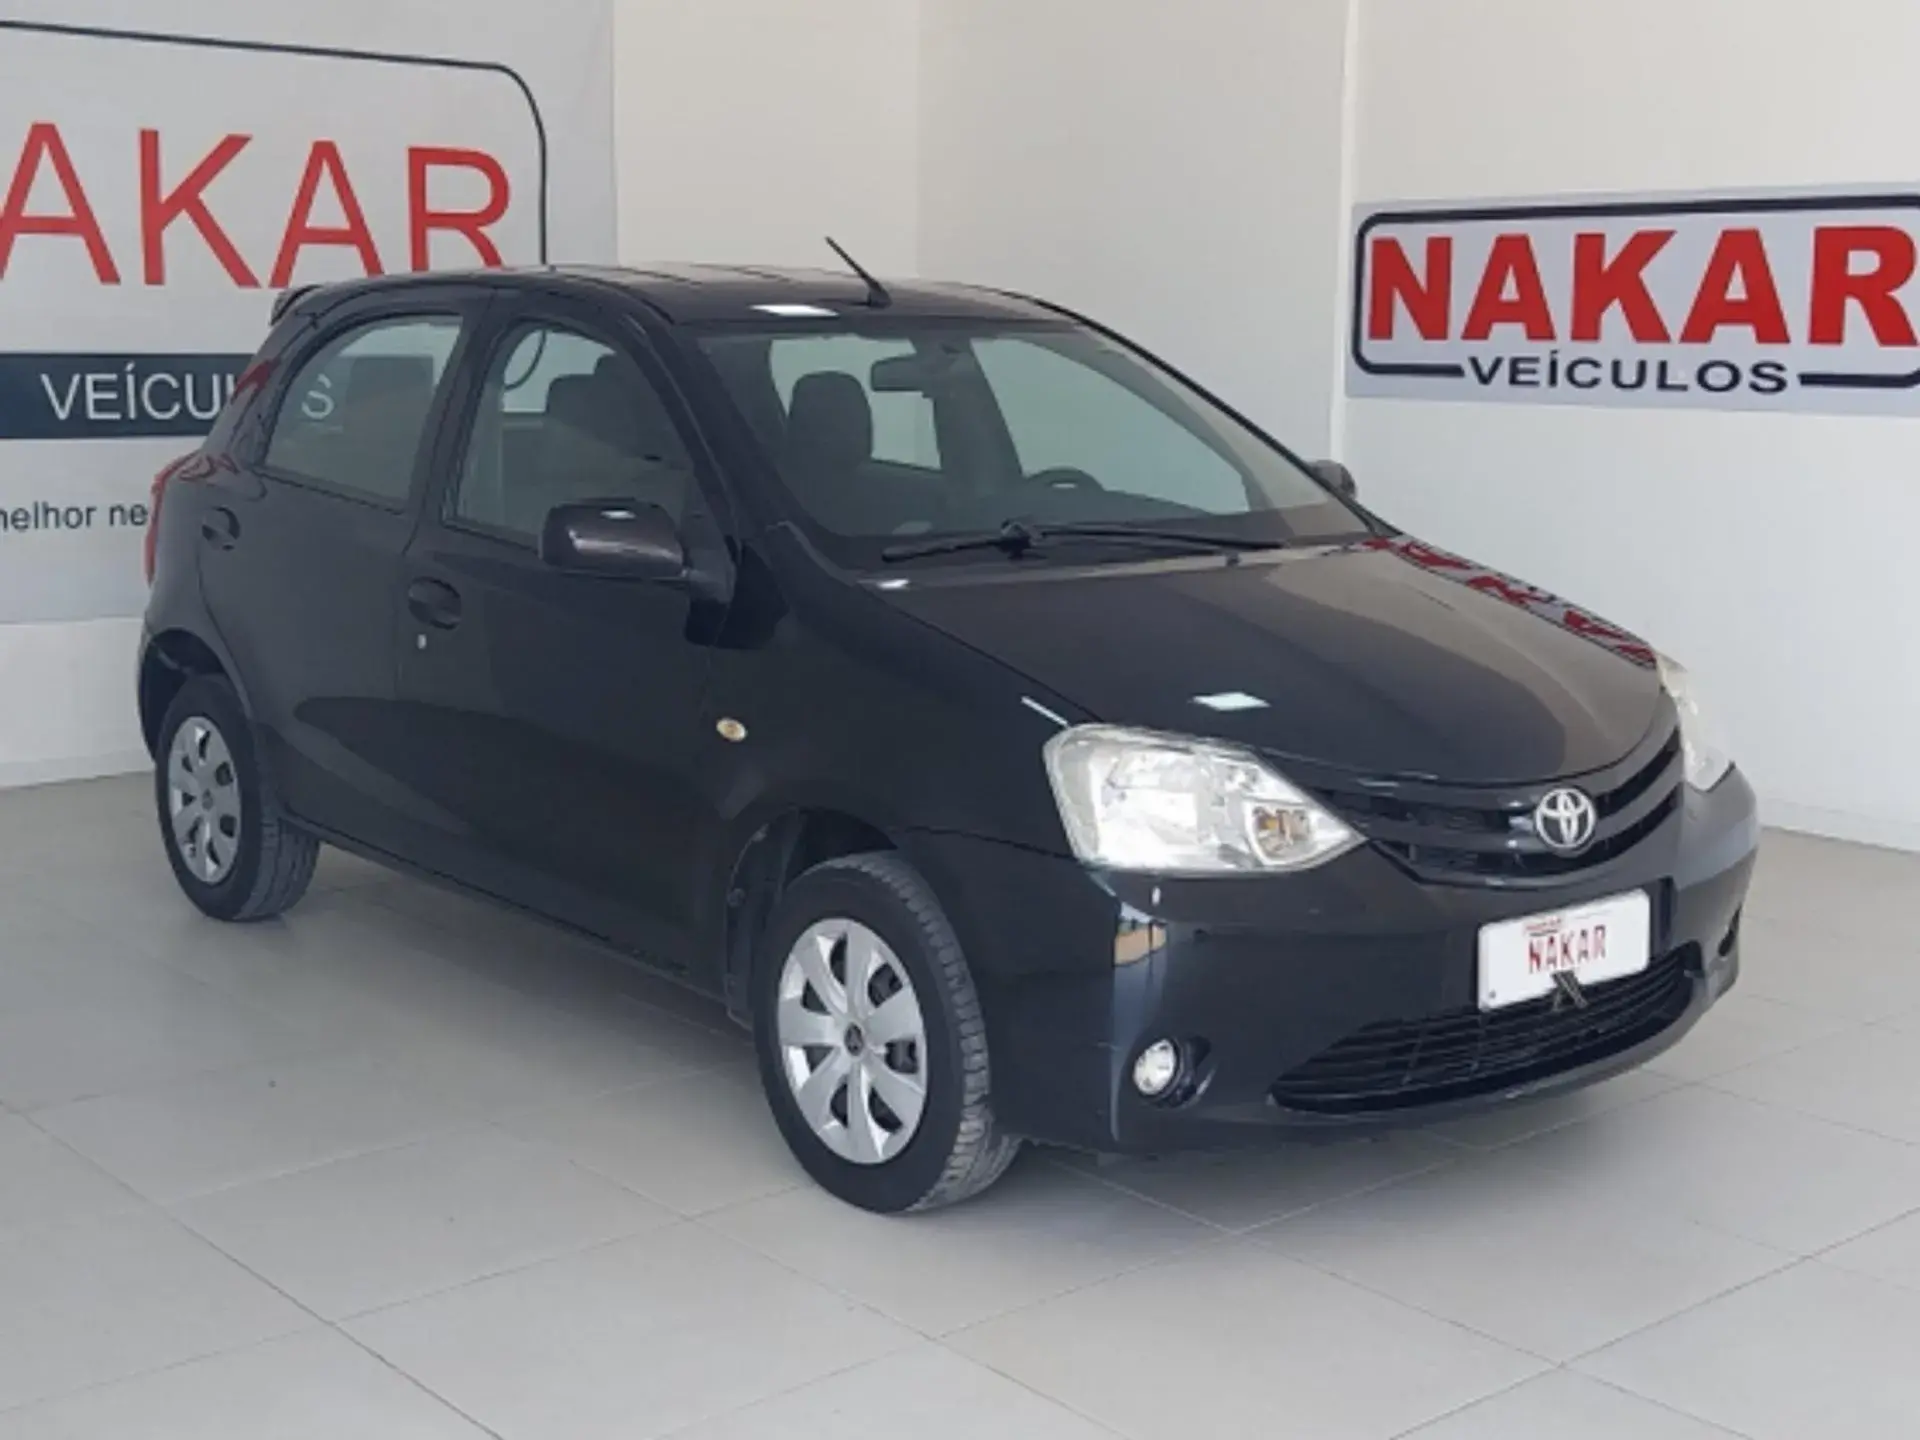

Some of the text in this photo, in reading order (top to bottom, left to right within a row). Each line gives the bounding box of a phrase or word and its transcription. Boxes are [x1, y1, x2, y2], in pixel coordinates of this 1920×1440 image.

[1368, 226, 1919, 346] NAKAR
[1467, 350, 1789, 394] VEÍCULOS
[1528, 924, 1606, 974] NAKAR
